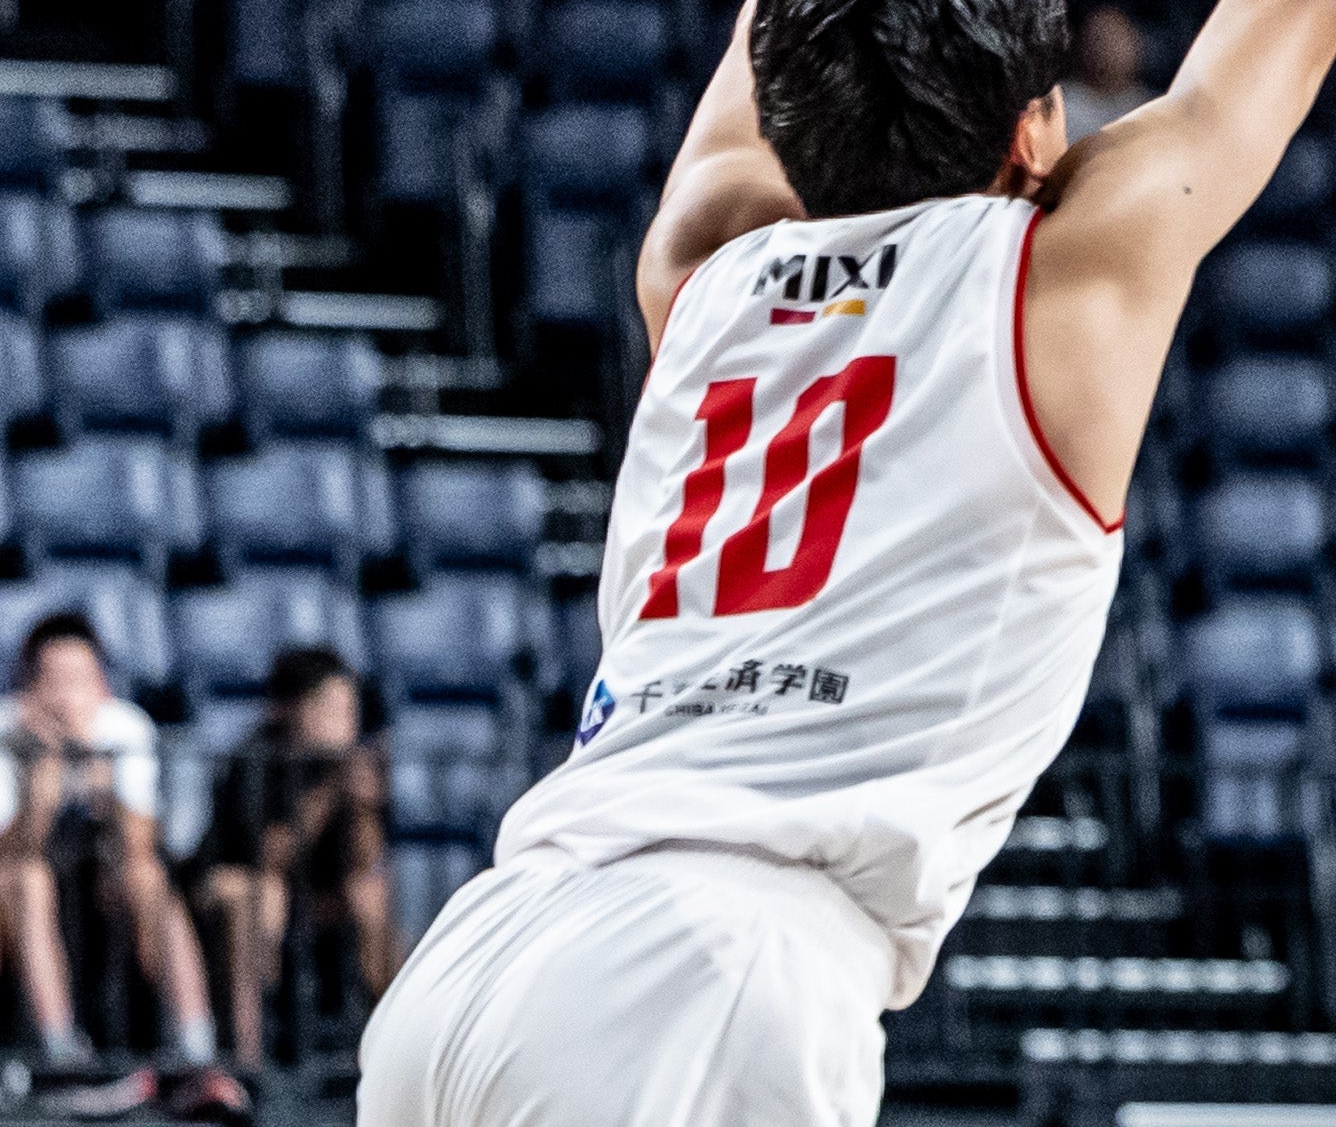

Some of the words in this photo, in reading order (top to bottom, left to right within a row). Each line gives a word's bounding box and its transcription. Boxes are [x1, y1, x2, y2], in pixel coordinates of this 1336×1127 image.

[752, 244, 898, 302] MIXI
[638, 355, 897, 621] 10
[631, 658, 850, 715] 千済学園
